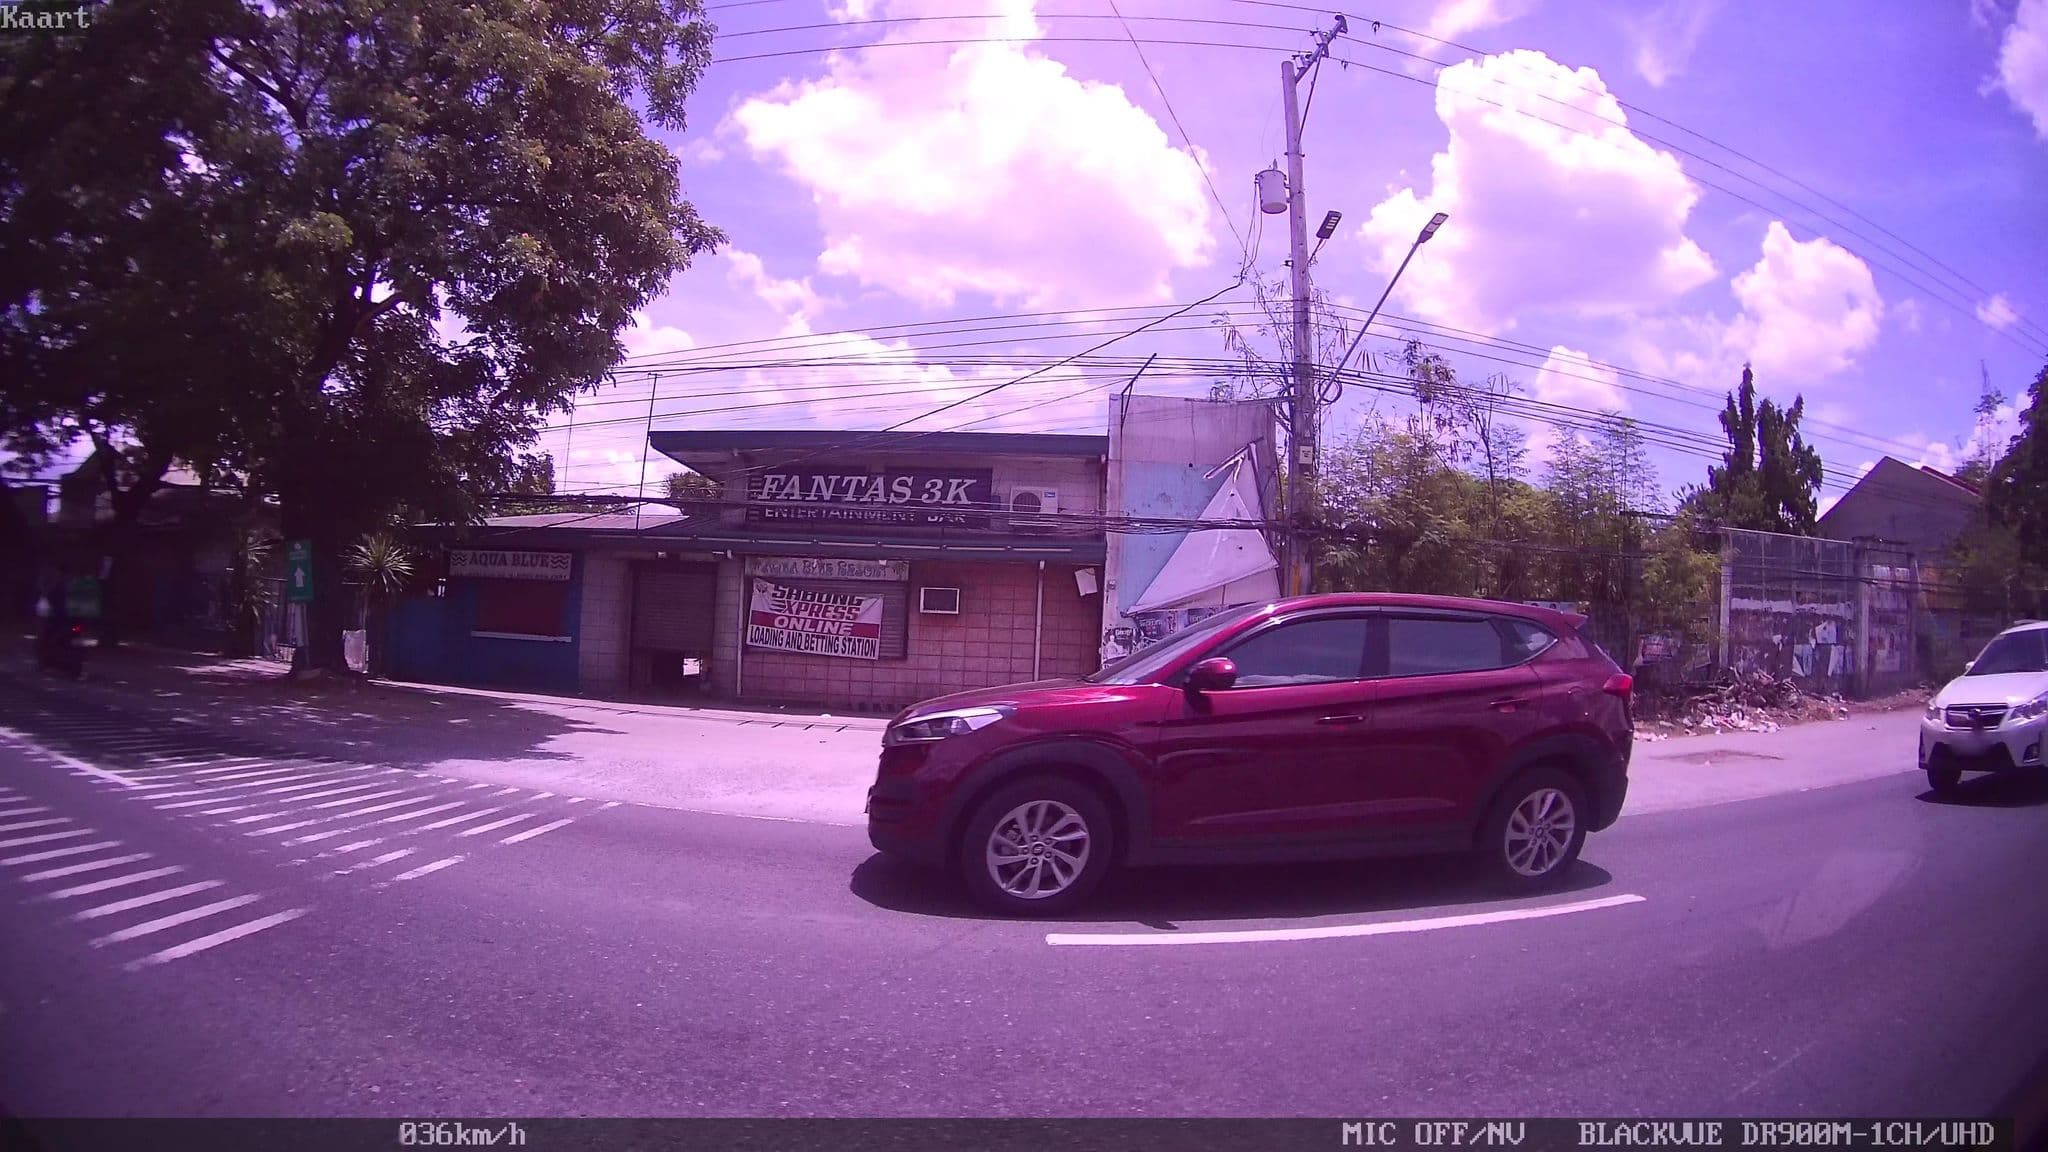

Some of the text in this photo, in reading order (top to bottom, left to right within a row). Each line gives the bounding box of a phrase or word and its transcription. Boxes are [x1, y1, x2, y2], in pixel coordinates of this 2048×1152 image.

[758, 474, 978, 506] FANTAS 3K
[469, 551, 550, 568] AQUA BLUE
[769, 599, 862, 621] EXPRESS
[774, 615, 854, 636] ONLINE
[750, 625, 878, 658] LOADING AND BETTING STATION
